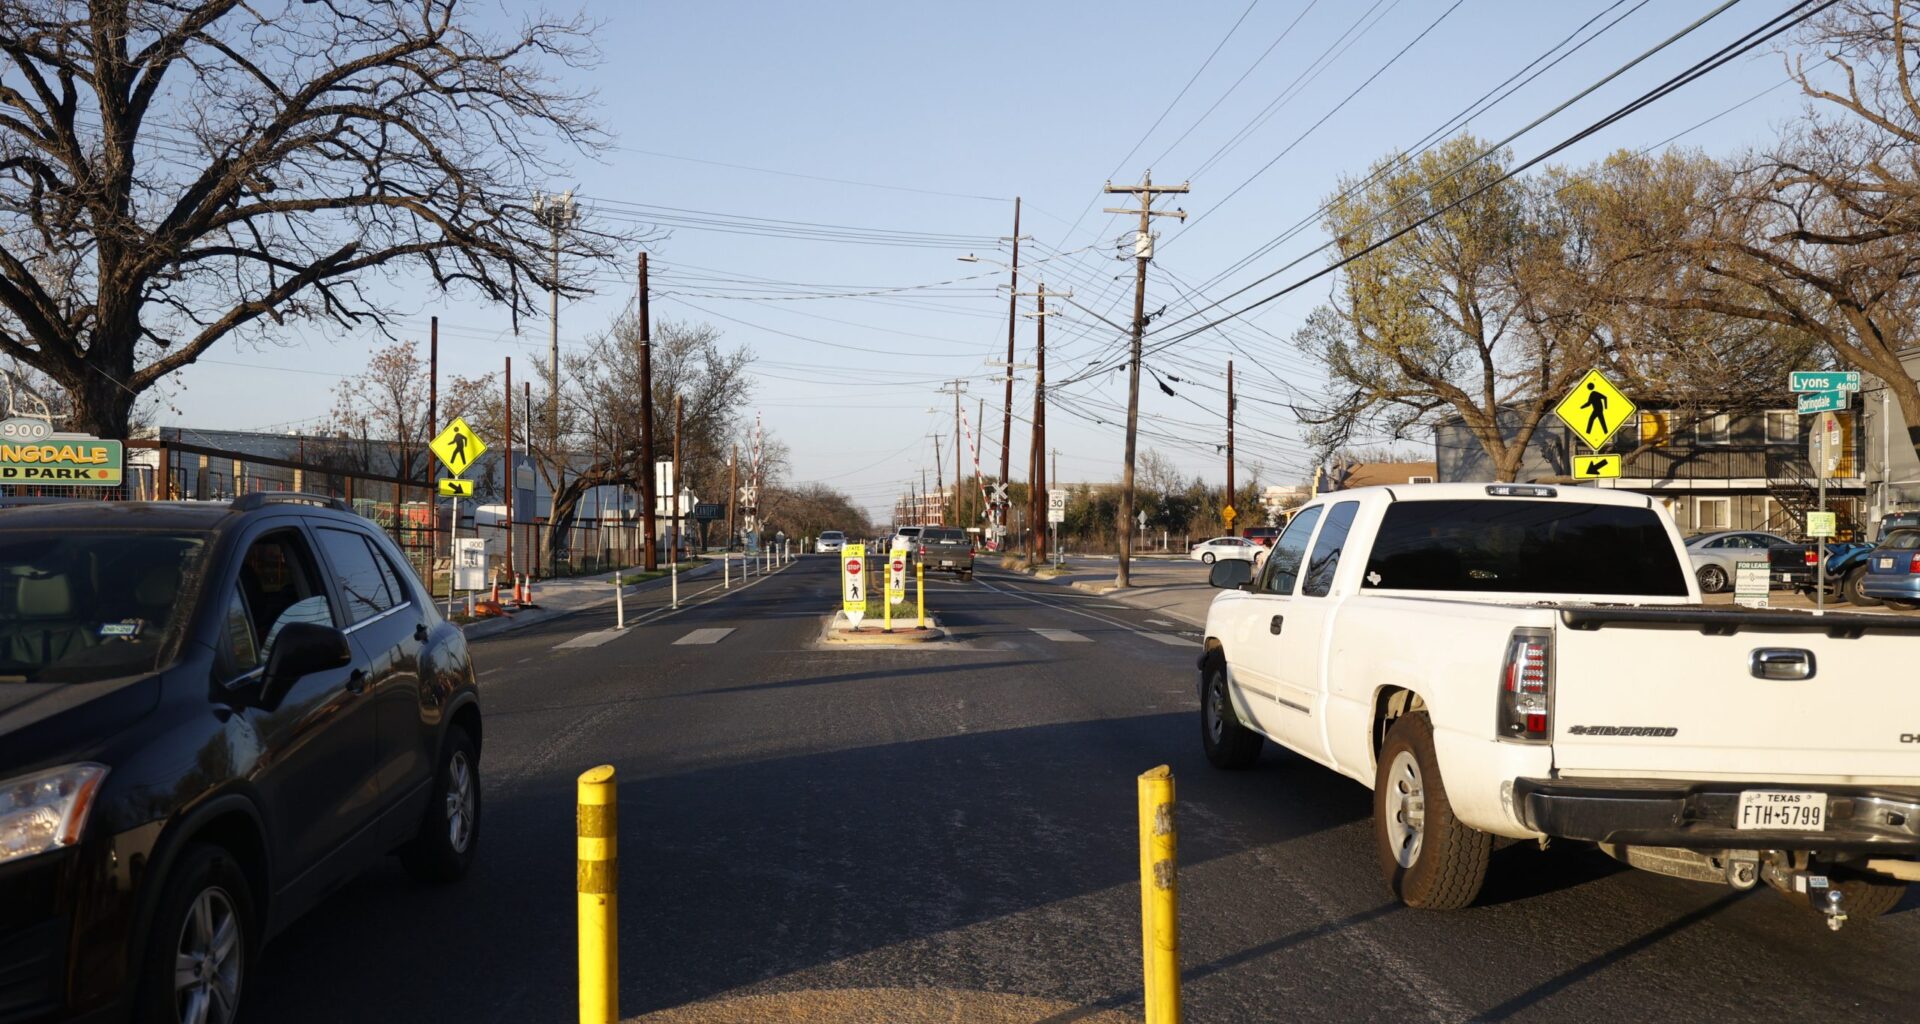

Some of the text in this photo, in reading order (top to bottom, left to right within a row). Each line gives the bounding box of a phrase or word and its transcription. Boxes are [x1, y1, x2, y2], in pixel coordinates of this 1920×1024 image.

[1793, 375, 1830, 390] Lyons
[1799, 395, 1830, 411] Springdale
[4, 424, 46, 437] 900
[0, 445, 109, 464] NGDALE
[3, 467, 92, 479] D PARK
[1051, 499, 1063, 508] 30
[1768, 794, 1801, 802] TEXAS
